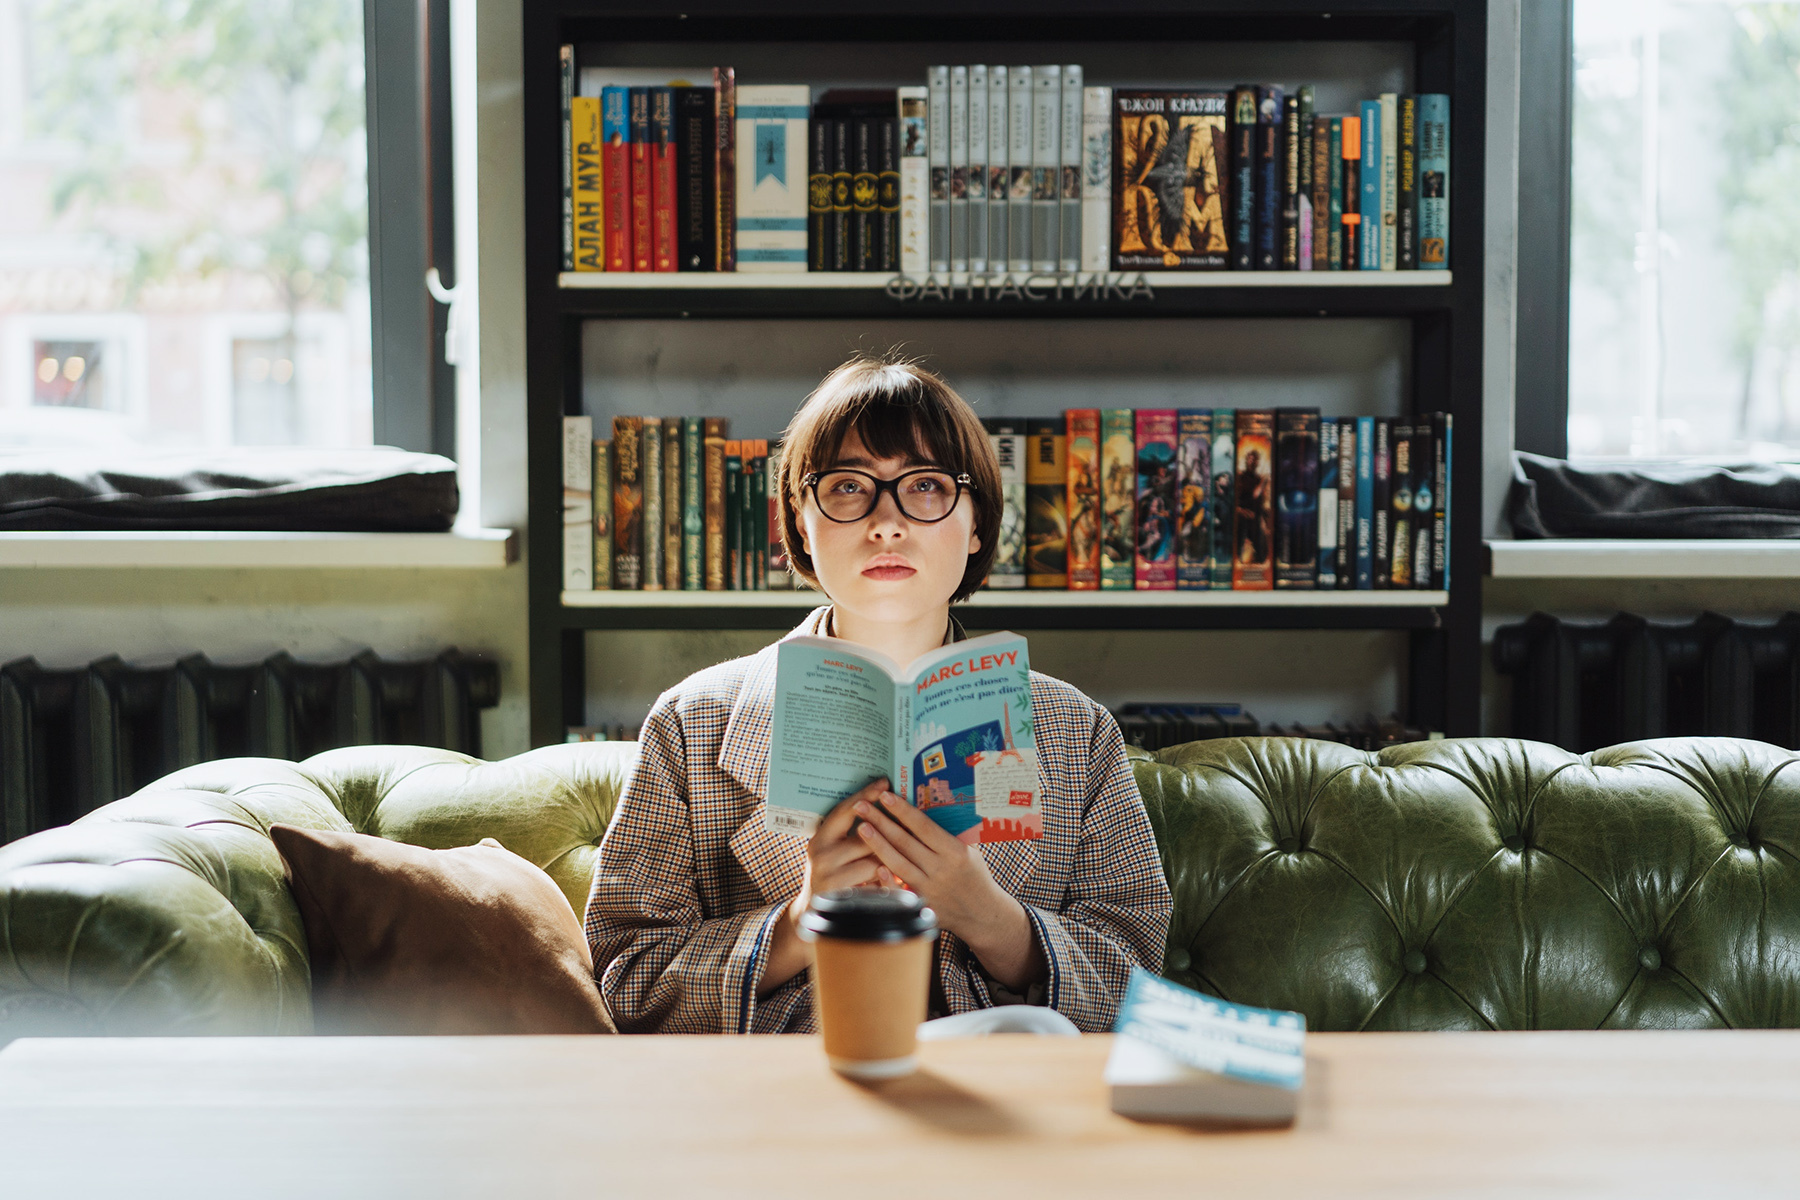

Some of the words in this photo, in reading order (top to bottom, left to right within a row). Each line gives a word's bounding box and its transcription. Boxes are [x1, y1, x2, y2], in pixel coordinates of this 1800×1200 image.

[1118, 97, 1165, 113] ДЖОН
[1169, 97, 1227, 113] КРАУЛИ
[578, 142, 600, 191] МУР
[1402, 150, 1413, 191] РОДЖЕР
[578, 202, 600, 268] АЛАН
[886, 271, 1155, 302] ФАНТАСТИКА
[823, 659, 845, 668] MARC
[845, 663, 863, 673] LEVY
[917, 662, 964, 695] MARC
[968, 650, 1018, 673] LEVY
[924, 687, 953, 703] Toutes
[955, 683, 972, 692] ces
[974, 676, 1009, 688] choses
[939, 698, 952, 708] ne
[954, 693, 975, 703] s'est
[978, 690, 996, 700] pas
[998, 685, 1024, 695] dites
[900, 765, 908, 782] LEVY
